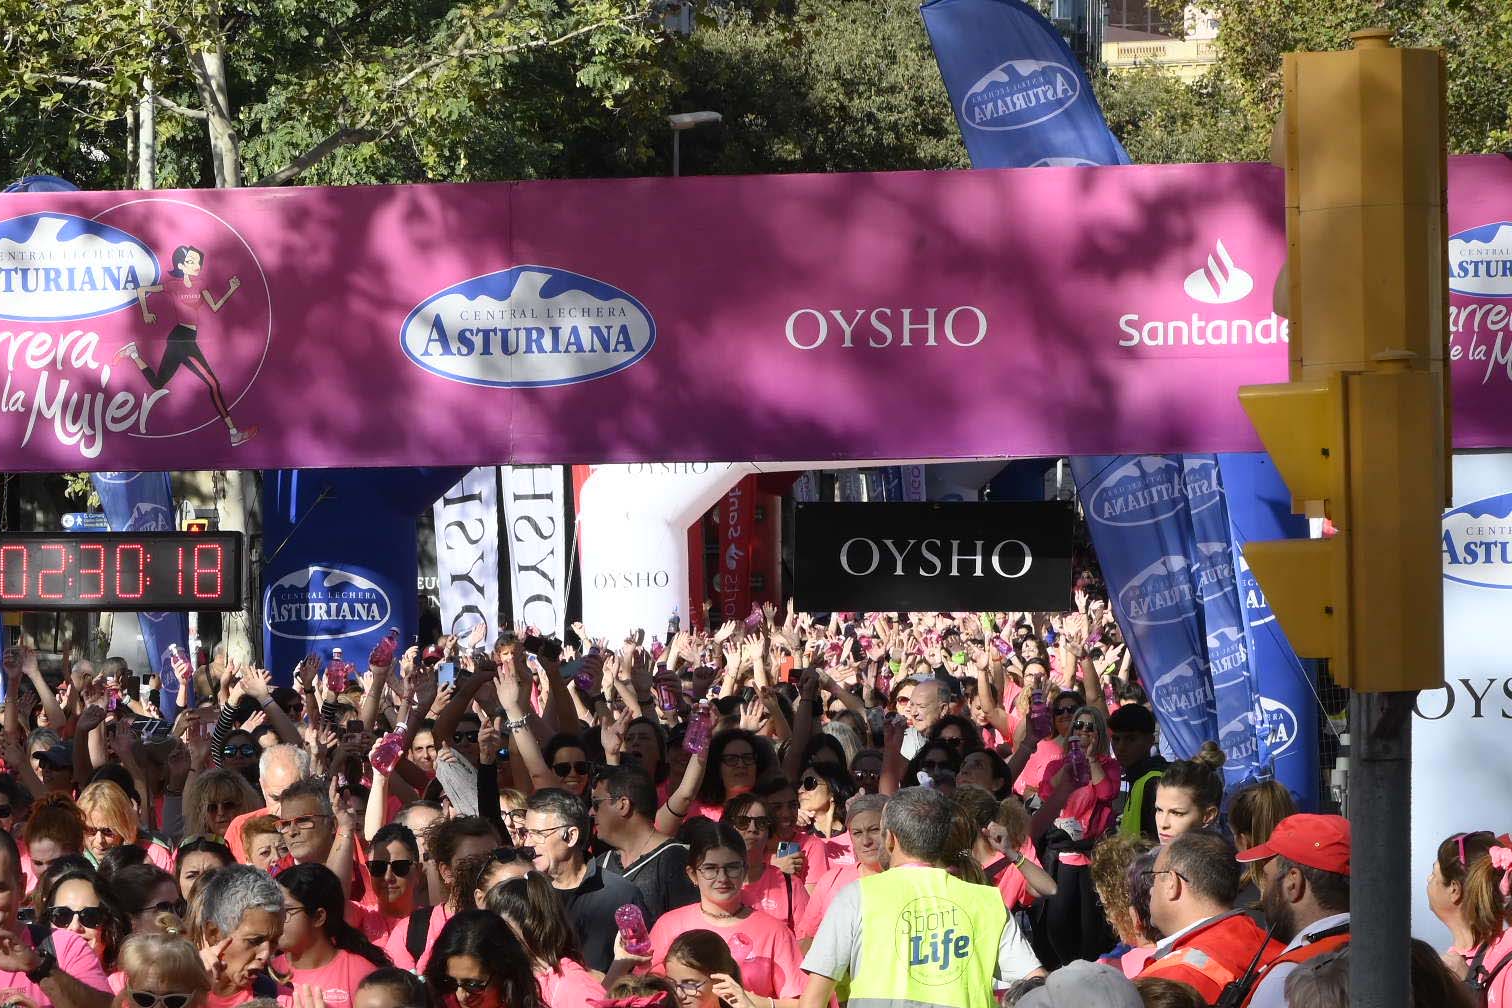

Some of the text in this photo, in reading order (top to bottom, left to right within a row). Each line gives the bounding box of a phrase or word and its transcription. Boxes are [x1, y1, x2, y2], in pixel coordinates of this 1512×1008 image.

[459, 306, 628, 321] CENTRAL LECHERA
[784, 306, 988, 350] OYSHO
[420, 313, 636, 357] ASTURIANA
[0, 371, 26, 413] la
[20, 364, 170, 459] Mujer
[0, 544, 221, 599] 02:30:18
[839, 537, 1033, 579] OYSHO
[594, 570, 669, 590] OYSHO
[270, 597, 382, 624] ASTURIANA
[901, 905, 959, 936] Sport
[909, 928, 970, 970] Life
